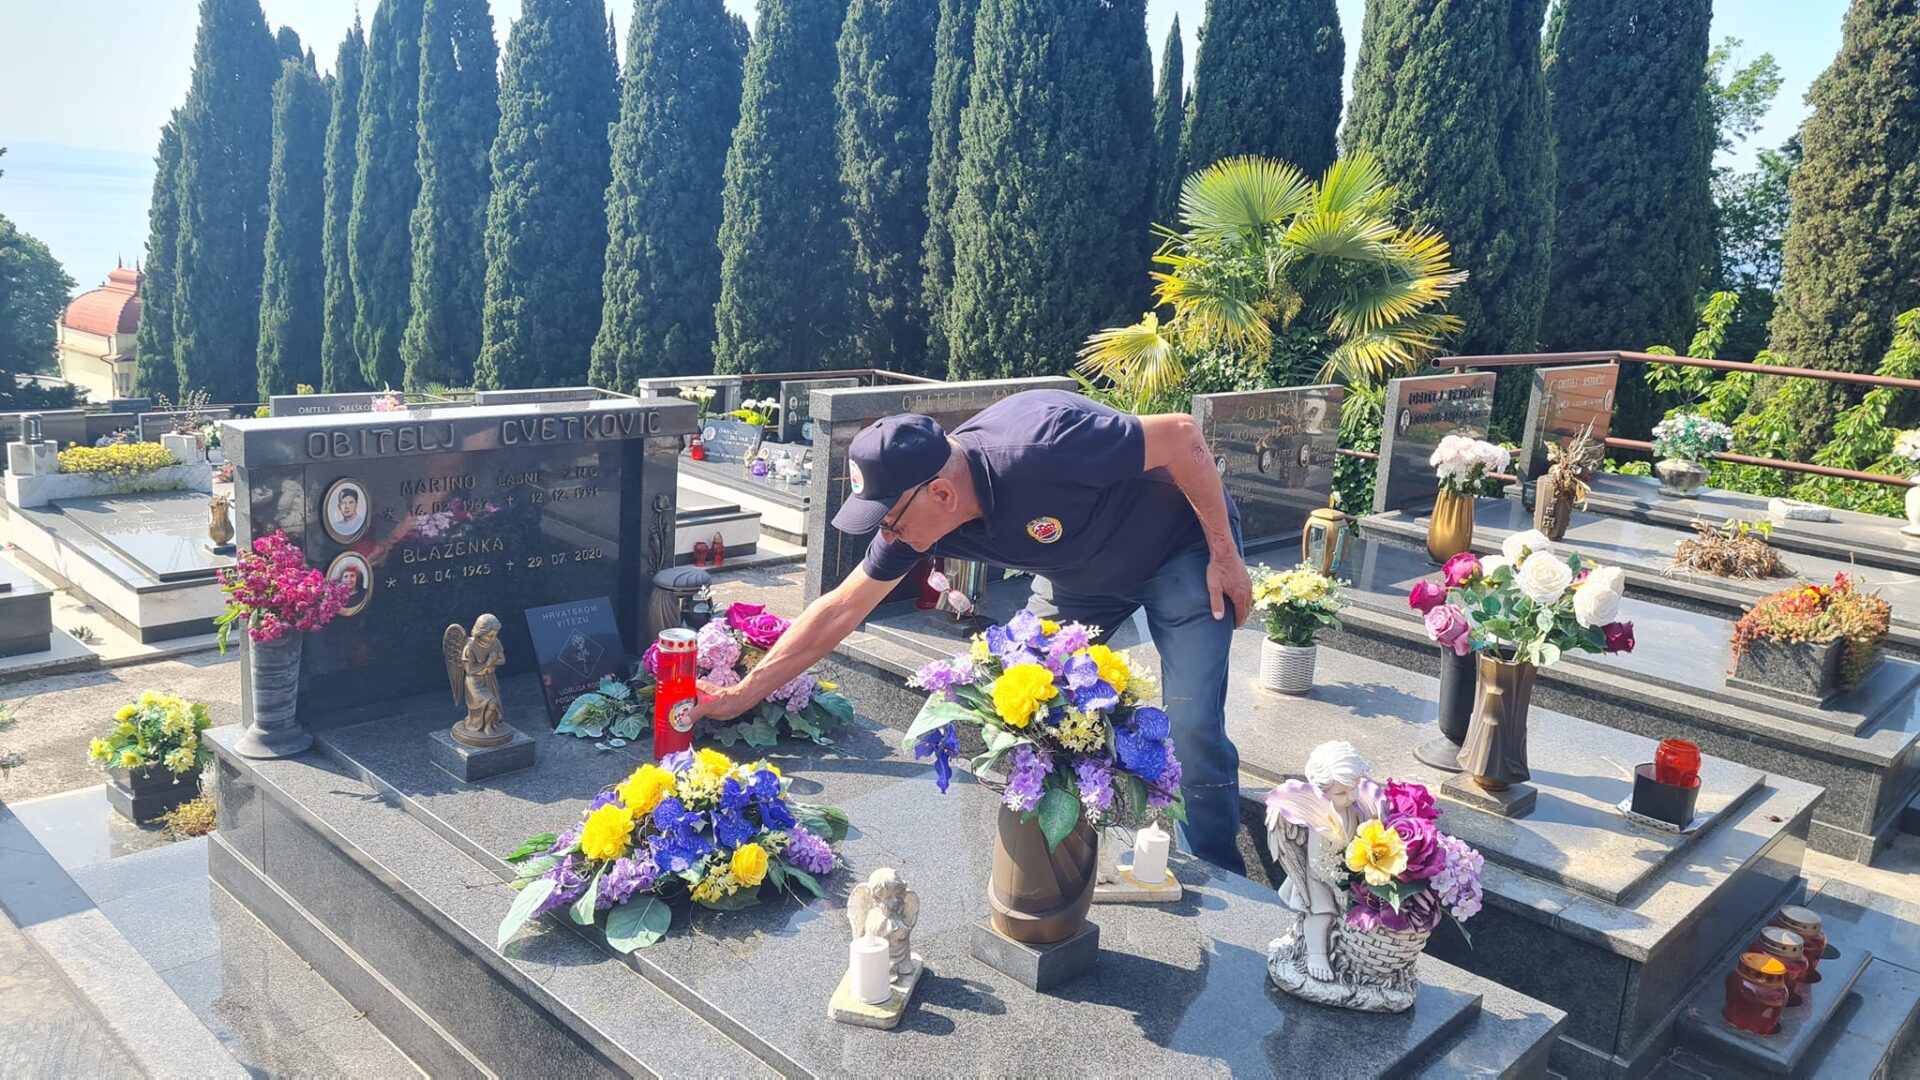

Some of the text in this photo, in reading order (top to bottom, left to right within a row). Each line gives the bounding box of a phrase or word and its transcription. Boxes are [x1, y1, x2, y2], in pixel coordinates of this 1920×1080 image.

[306, 406, 661, 459] OBITELJ CVETKOVIĆ
[400, 474, 476, 497] MARINO
[462, 563, 491, 577] 1945
[574, 547, 602, 561] 2020
[541, 604, 598, 621] HRVATSKOM
[555, 616, 590, 628] VITEZU
